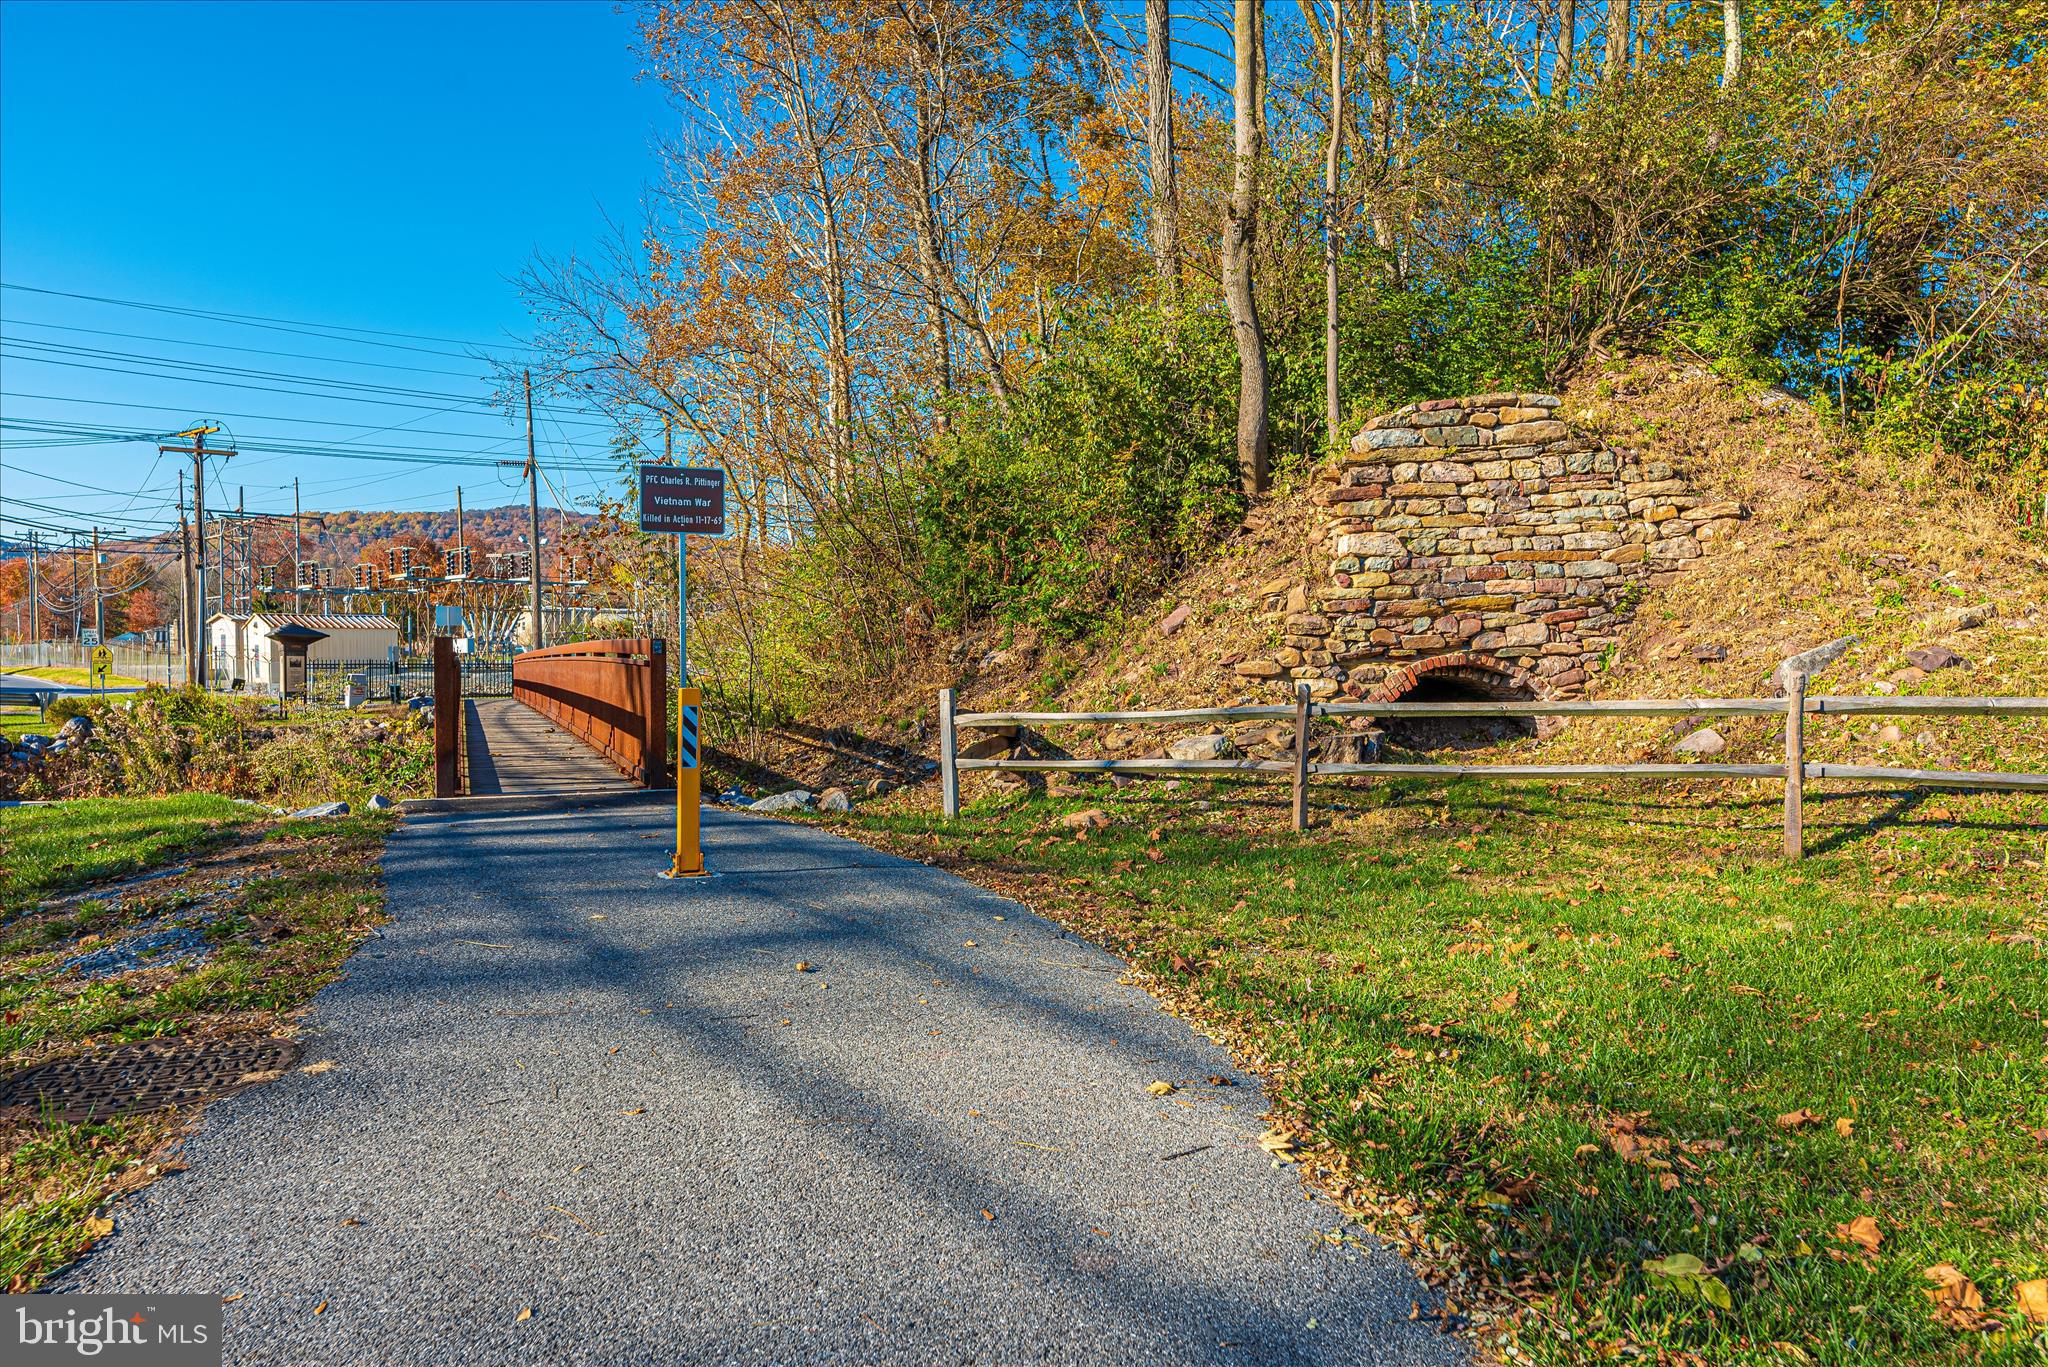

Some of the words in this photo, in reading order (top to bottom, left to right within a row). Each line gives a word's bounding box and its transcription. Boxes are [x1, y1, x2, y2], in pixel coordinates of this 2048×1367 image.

[645, 475, 658, 484] PFC
[660, 476, 683, 485] Charles
[685, 477, 692, 486] R.
[694, 477, 720, 488] Pittinger
[654, 496, 692, 506] Vietnam
[694, 498, 712, 507] War
[642, 514, 662, 522] Killed
[664, 514, 670, 522] in
[672, 515, 694, 524] Action
[695, 515, 722, 525] 11-17-69
[84, 637, 98, 645] 25
